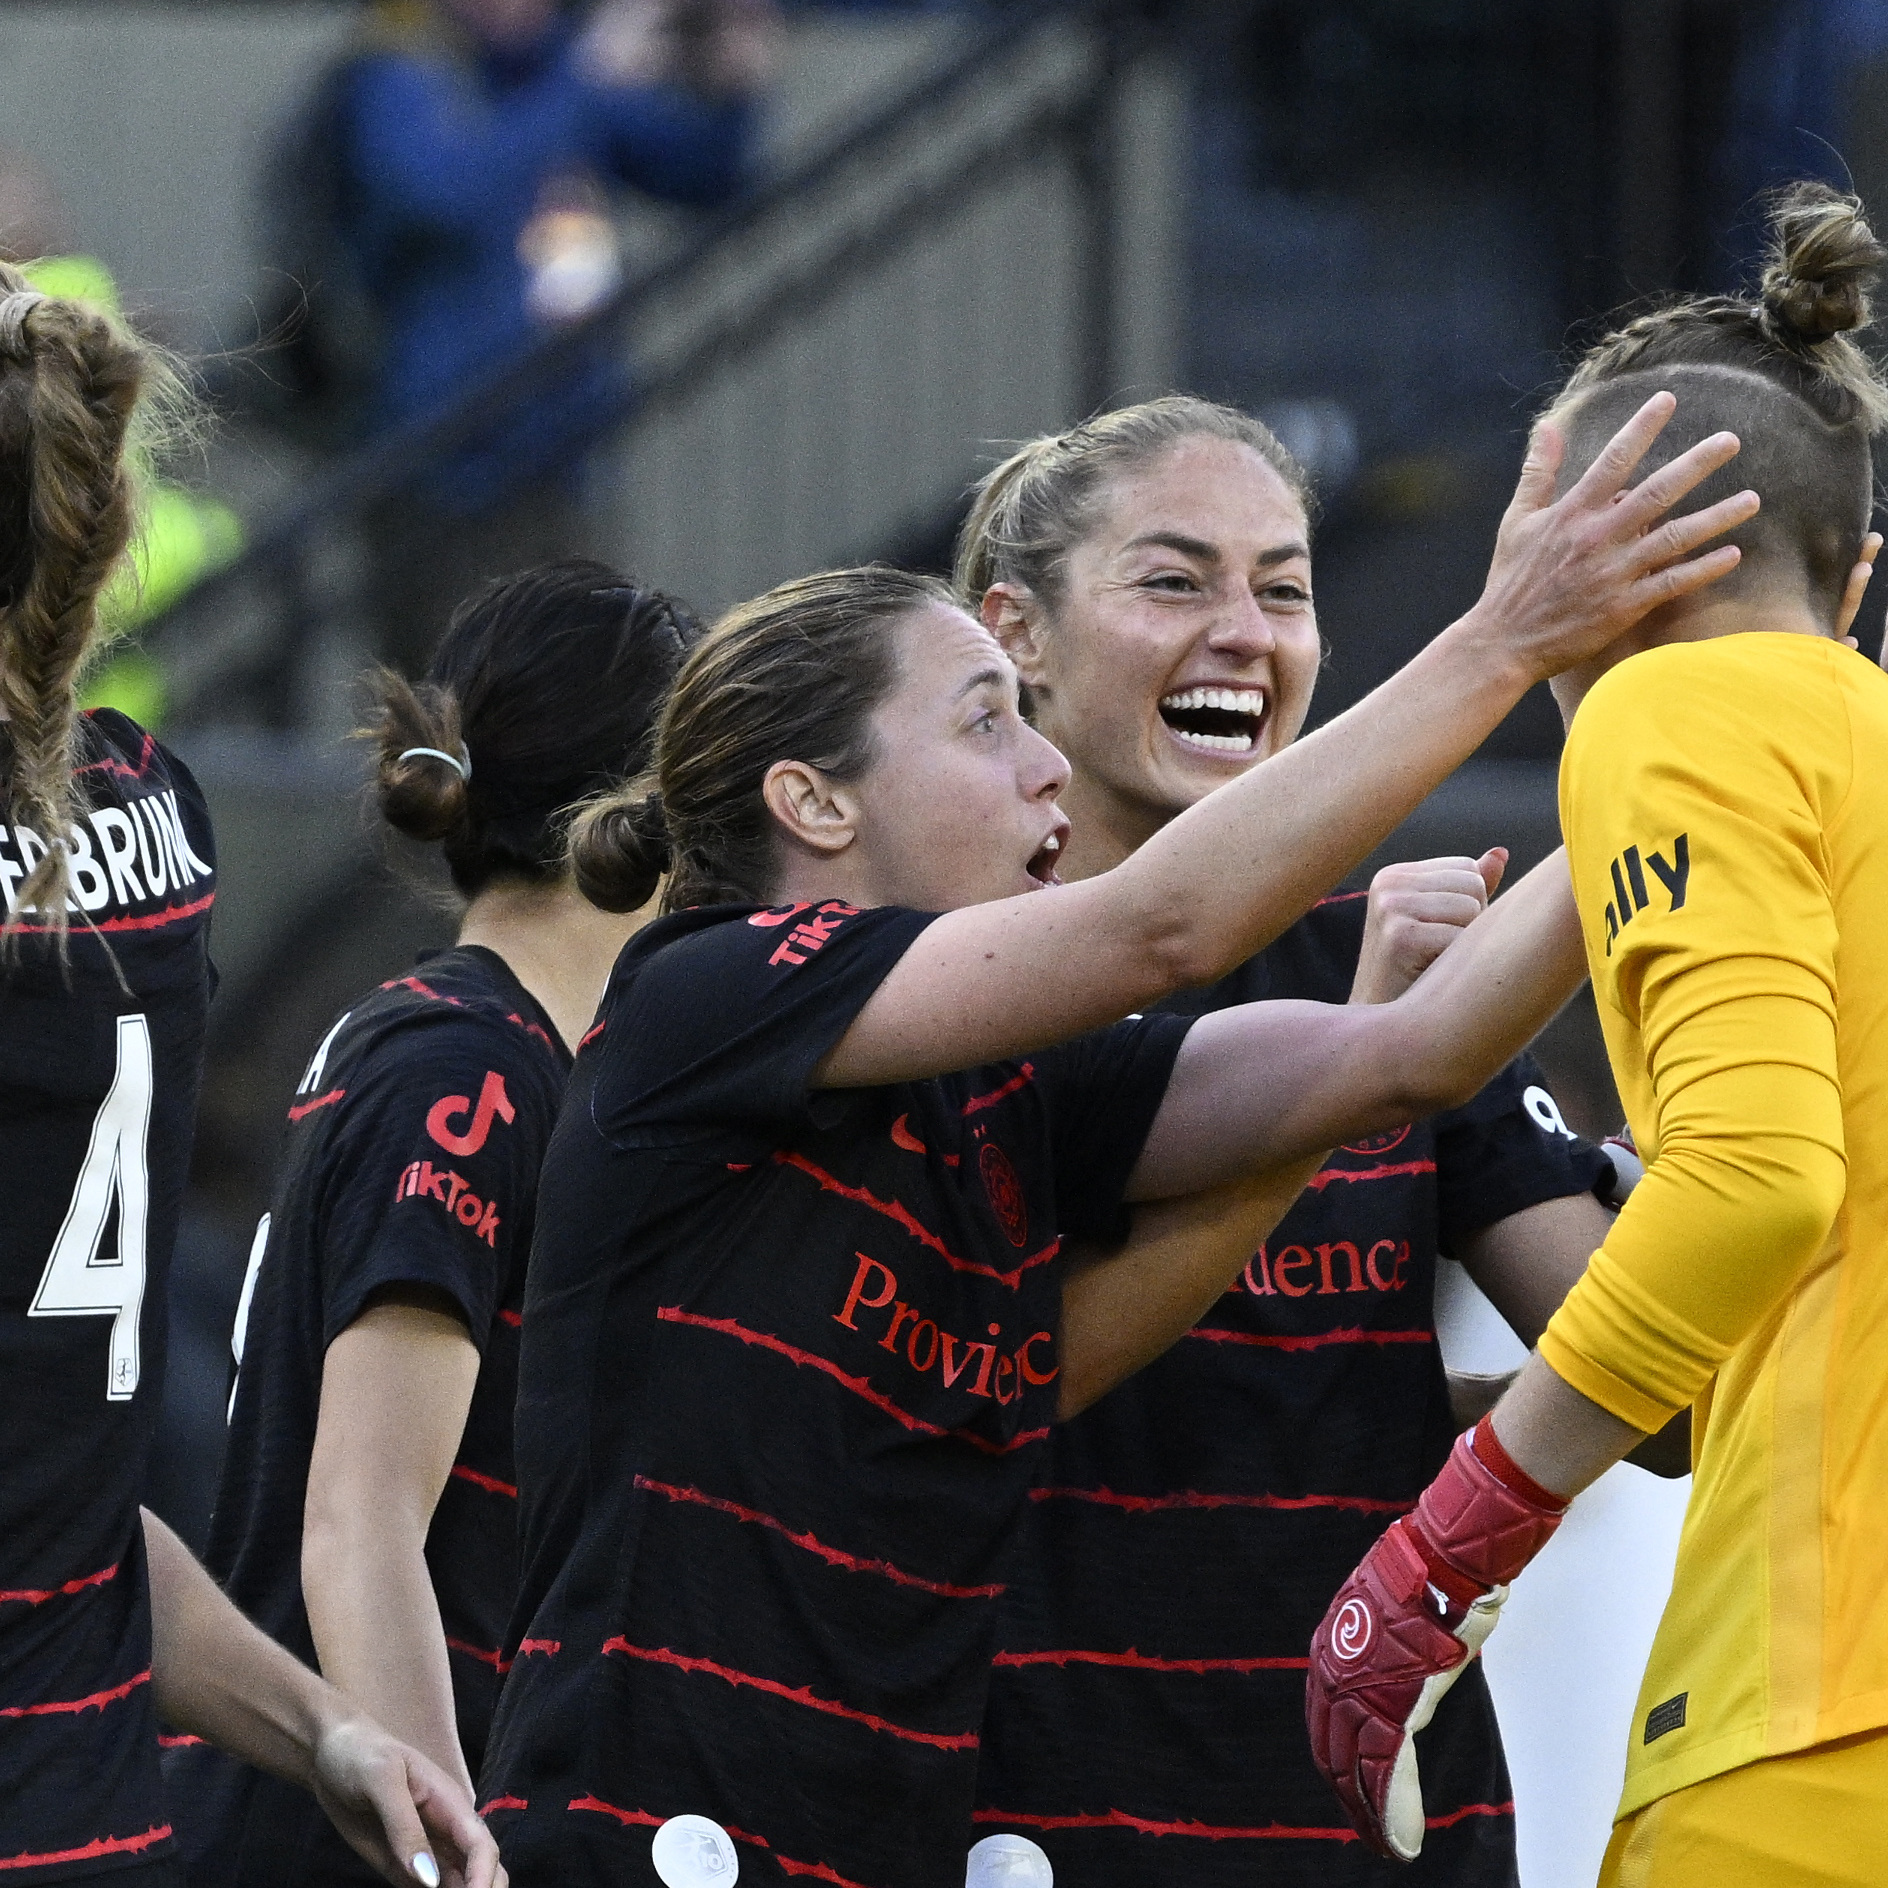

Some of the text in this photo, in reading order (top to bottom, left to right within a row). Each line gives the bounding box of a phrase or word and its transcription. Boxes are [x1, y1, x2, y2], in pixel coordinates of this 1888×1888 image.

[1605, 832, 1690, 957] ally
[27, 1014, 152, 1401] 4
[395, 1160, 501, 1248] TikTok
